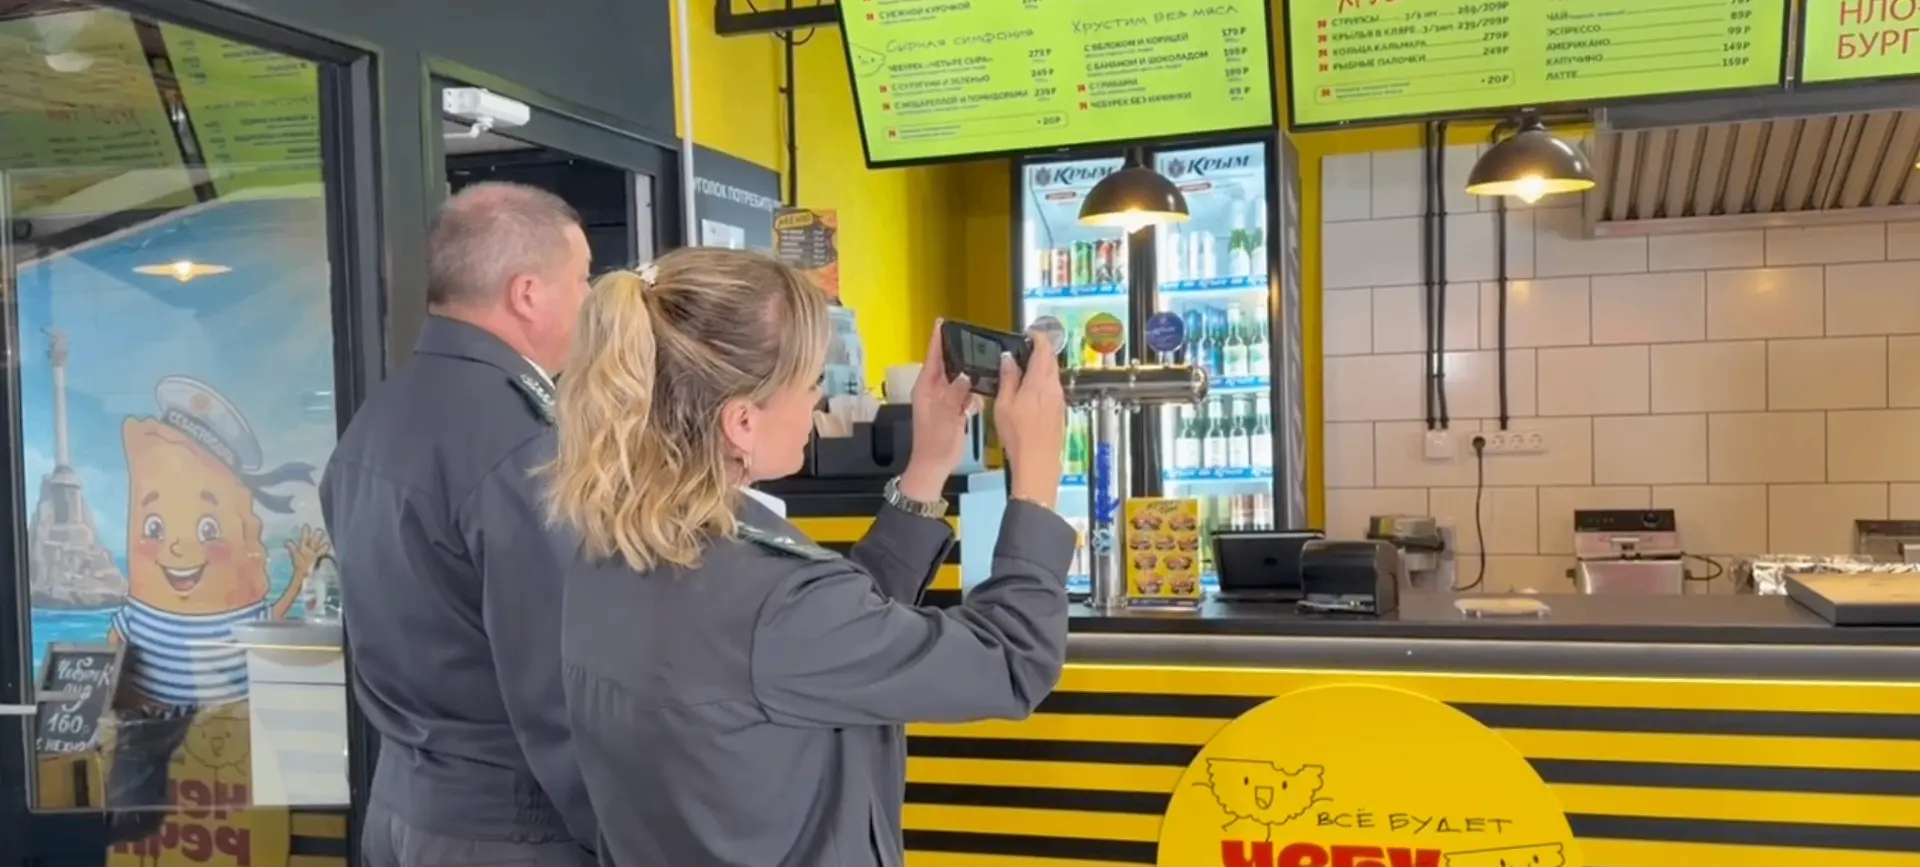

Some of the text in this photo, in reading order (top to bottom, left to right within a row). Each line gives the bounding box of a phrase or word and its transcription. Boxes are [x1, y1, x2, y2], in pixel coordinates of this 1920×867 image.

[1331, 15, 1379, 27] СТРИПСЫ
[1547, 25, 1601, 36] ЭСПРЕССО
[1546, 38, 1611, 51] АМЕРИКАНО
[1094, 58, 1138, 71] БАНАНОМ
[1148, 51, 1209, 65] ШОКОЛАДОМ
[1378, 55, 1426, 66] ПАЛОЧКИ
[1546, 54, 1603, 66] КАПУЧИНО
[1546, 70, 1577, 81] ЛАТТЕ
[1131, 96, 1147, 105] БЕЗ
[1317, 808, 1512, 834] ВСЁ БУДЕТ
